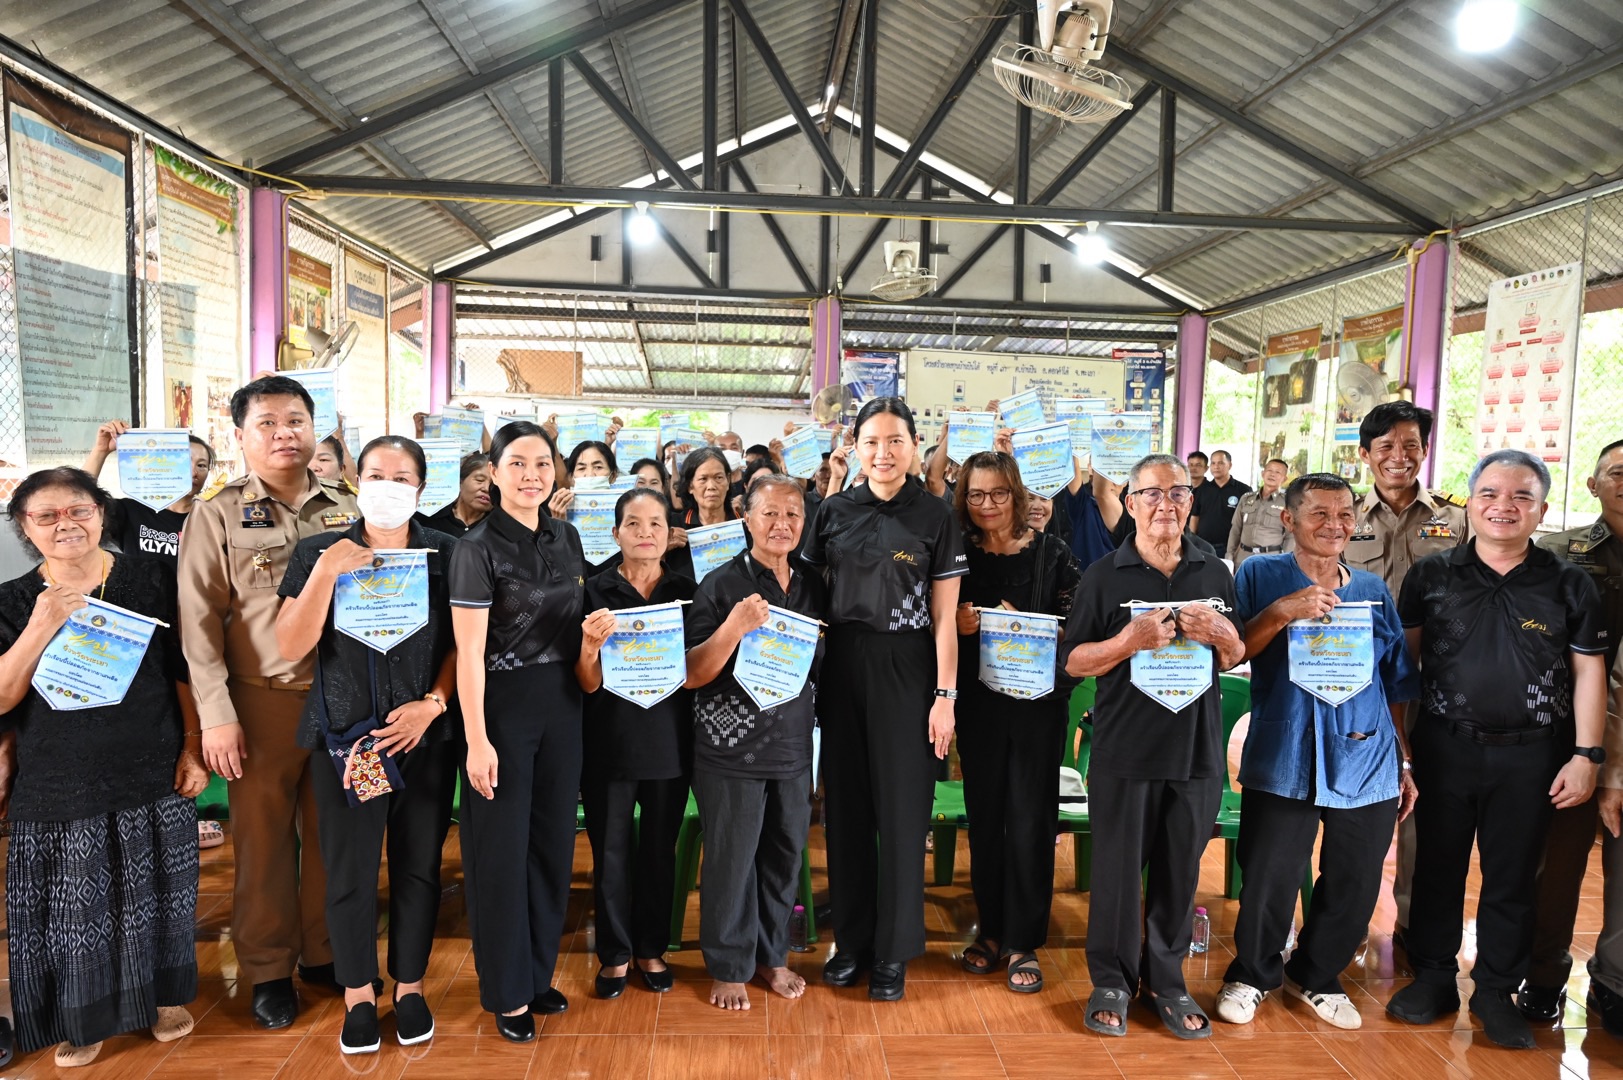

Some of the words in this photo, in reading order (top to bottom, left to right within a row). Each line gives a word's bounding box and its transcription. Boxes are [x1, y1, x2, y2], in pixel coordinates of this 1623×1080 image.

[140, 538, 177, 556] KLYN
[63, 645, 109, 667] จังหวัดพะเยา
[760, 651, 794, 666] จังหวัดพะเยา
[996, 655, 1034, 664] จังหวัดพะเยา
[1152, 652, 1194, 661] จังหวัดพะเยา
